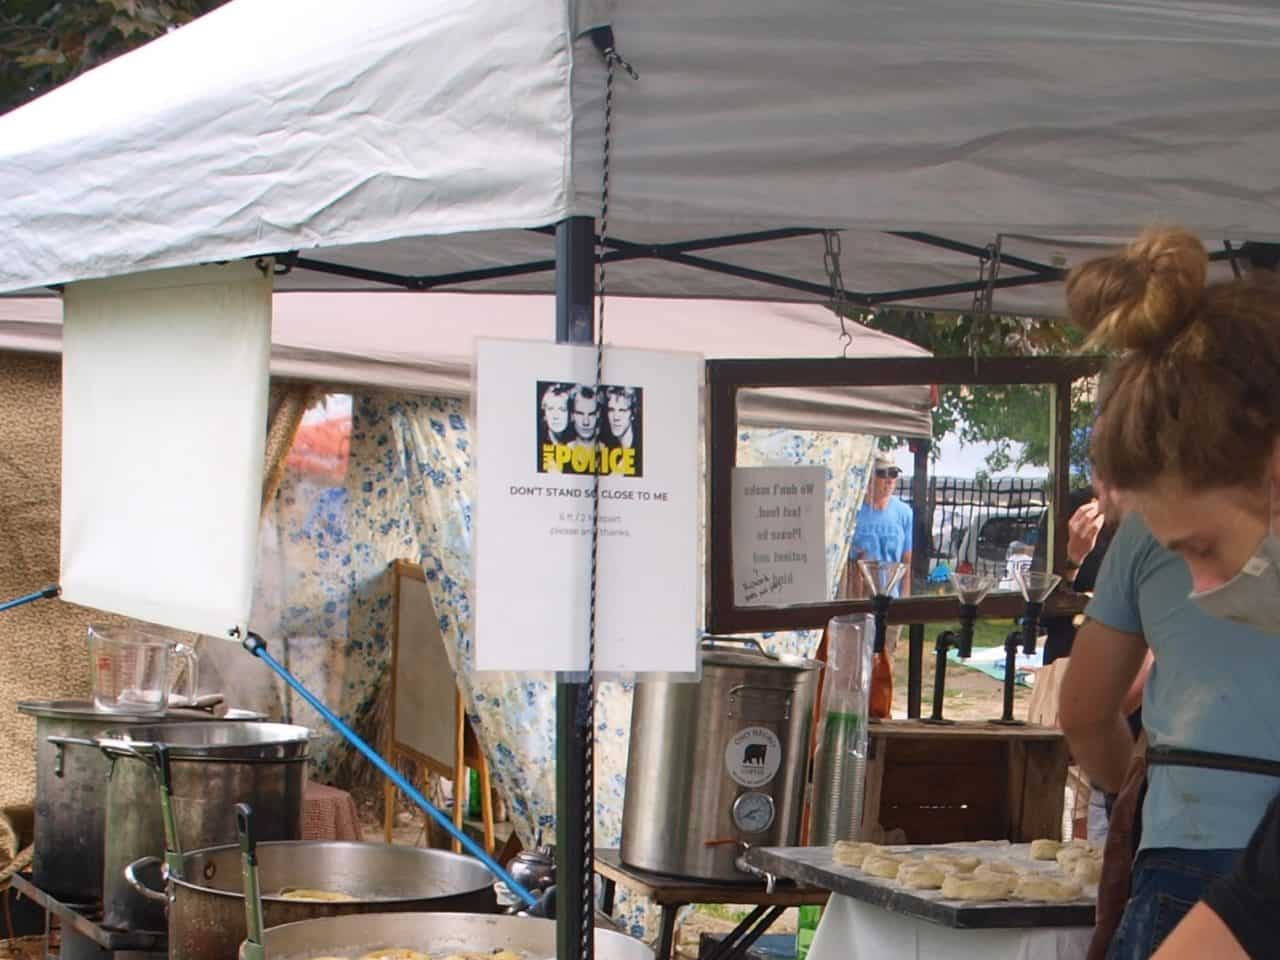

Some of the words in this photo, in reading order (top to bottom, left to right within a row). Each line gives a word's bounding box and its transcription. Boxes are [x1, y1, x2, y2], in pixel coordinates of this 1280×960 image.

[510, 486, 543, 496] DON'T
[546, 487, 581, 498] STAND
[601, 490, 633, 500] CLOSE
[637, 491, 650, 501] TO
[653, 492, 668, 502] ME
